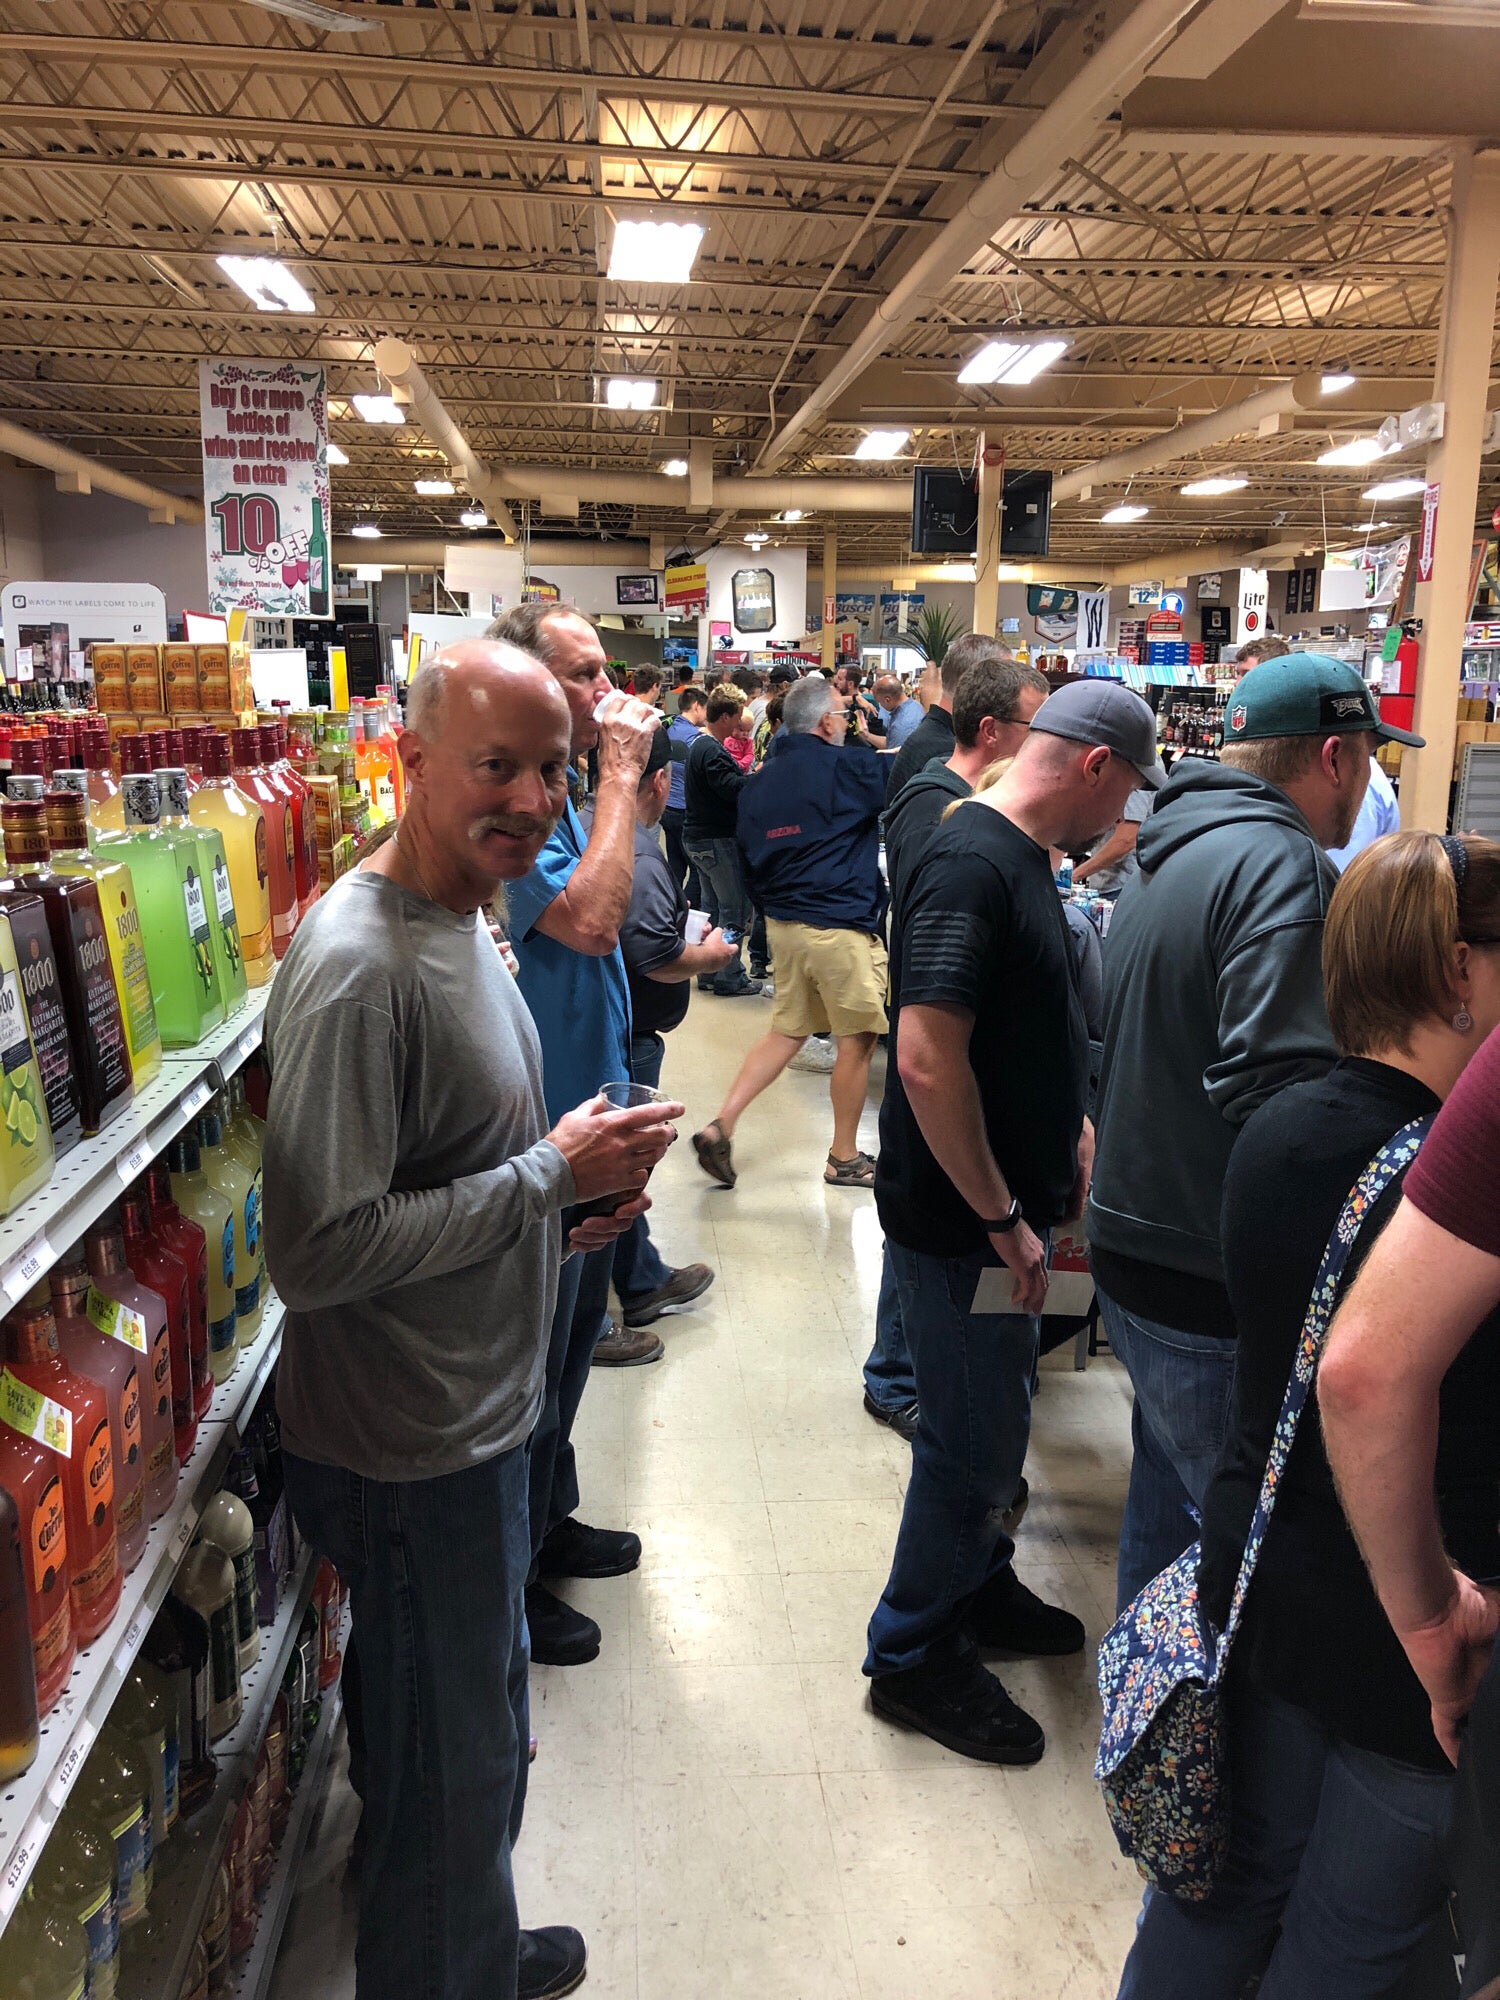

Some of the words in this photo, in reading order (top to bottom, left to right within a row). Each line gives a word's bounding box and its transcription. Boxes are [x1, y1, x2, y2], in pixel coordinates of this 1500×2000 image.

[210, 383, 237, 409] Buy
[240, 384, 250, 409] 6
[251, 389, 267, 410] or
[268, 388, 305, 412] more
[226, 410, 274, 436] bottles
[275, 412, 290, 436] of
[204, 436, 238, 459] wine
[238, 437, 265, 460] and
[266, 440, 316, 463] receive
[233, 464, 251, 485] an
[252, 464, 287, 486] extra
[211, 492, 281, 557] 10
[265, 529, 310, 565] OFF
[28, 599, 56, 607] WATCH
[58, 599, 73, 607] THE
[75, 600, 101, 608] LABELS
[103, 600, 126, 608] COME
[128, 600, 139, 608] TO
[140, 600, 156, 608] LIFE
[836, 604, 872, 613] BUSCH
[882, 603, 922, 613] BUCH
[1243, 592, 1265, 610] Lite
[844, 636, 852, 650] 1
[116, 908, 138, 940] 1800
[79, 936, 107, 971] 1800
[22, 957, 54, 997] 1800
[87, 979, 112, 1000] ULTIMATE
[39, 1000, 49, 1010] THE
[87, 990, 116, 1014] MARGARITA
[88, 1001, 120, 1027] POMEGRANATE
[31, 1005, 60, 1026] ULTIMATE
[32, 1016, 65, 1040] MARGARITA
[21, 1257, 39, 1278] $15.99
[60, 1749, 80, 1784] $12.99
[8, 1848, 30, 1888] $13.99
